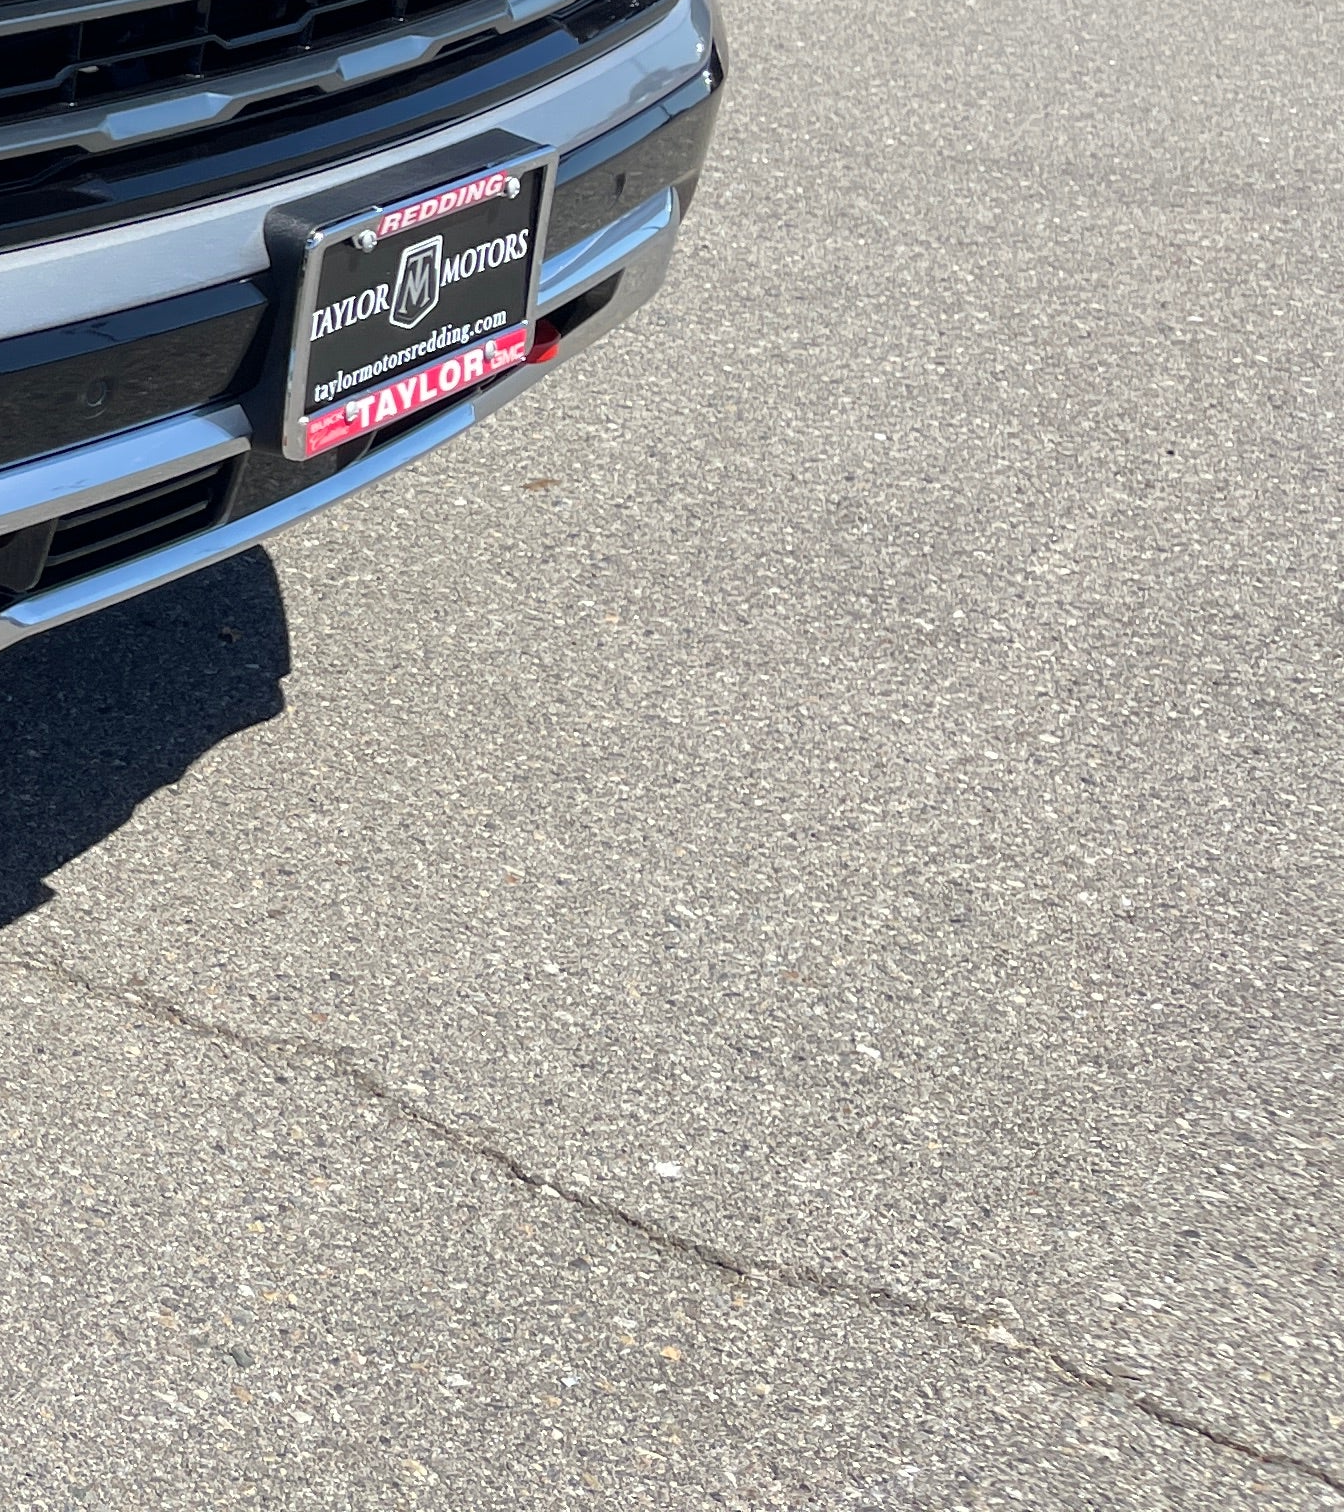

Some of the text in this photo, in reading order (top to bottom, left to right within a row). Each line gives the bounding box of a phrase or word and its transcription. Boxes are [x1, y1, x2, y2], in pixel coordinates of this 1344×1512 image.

[379, 173, 506, 234] REDDING
[309, 282, 391, 342] TAYLOR
[439, 228, 530, 288] MOTORS
[313, 309, 508, 403] taylormotorsredding.com
[354, 347, 485, 429] TAYLOR
[490, 341, 526, 370] GMC
